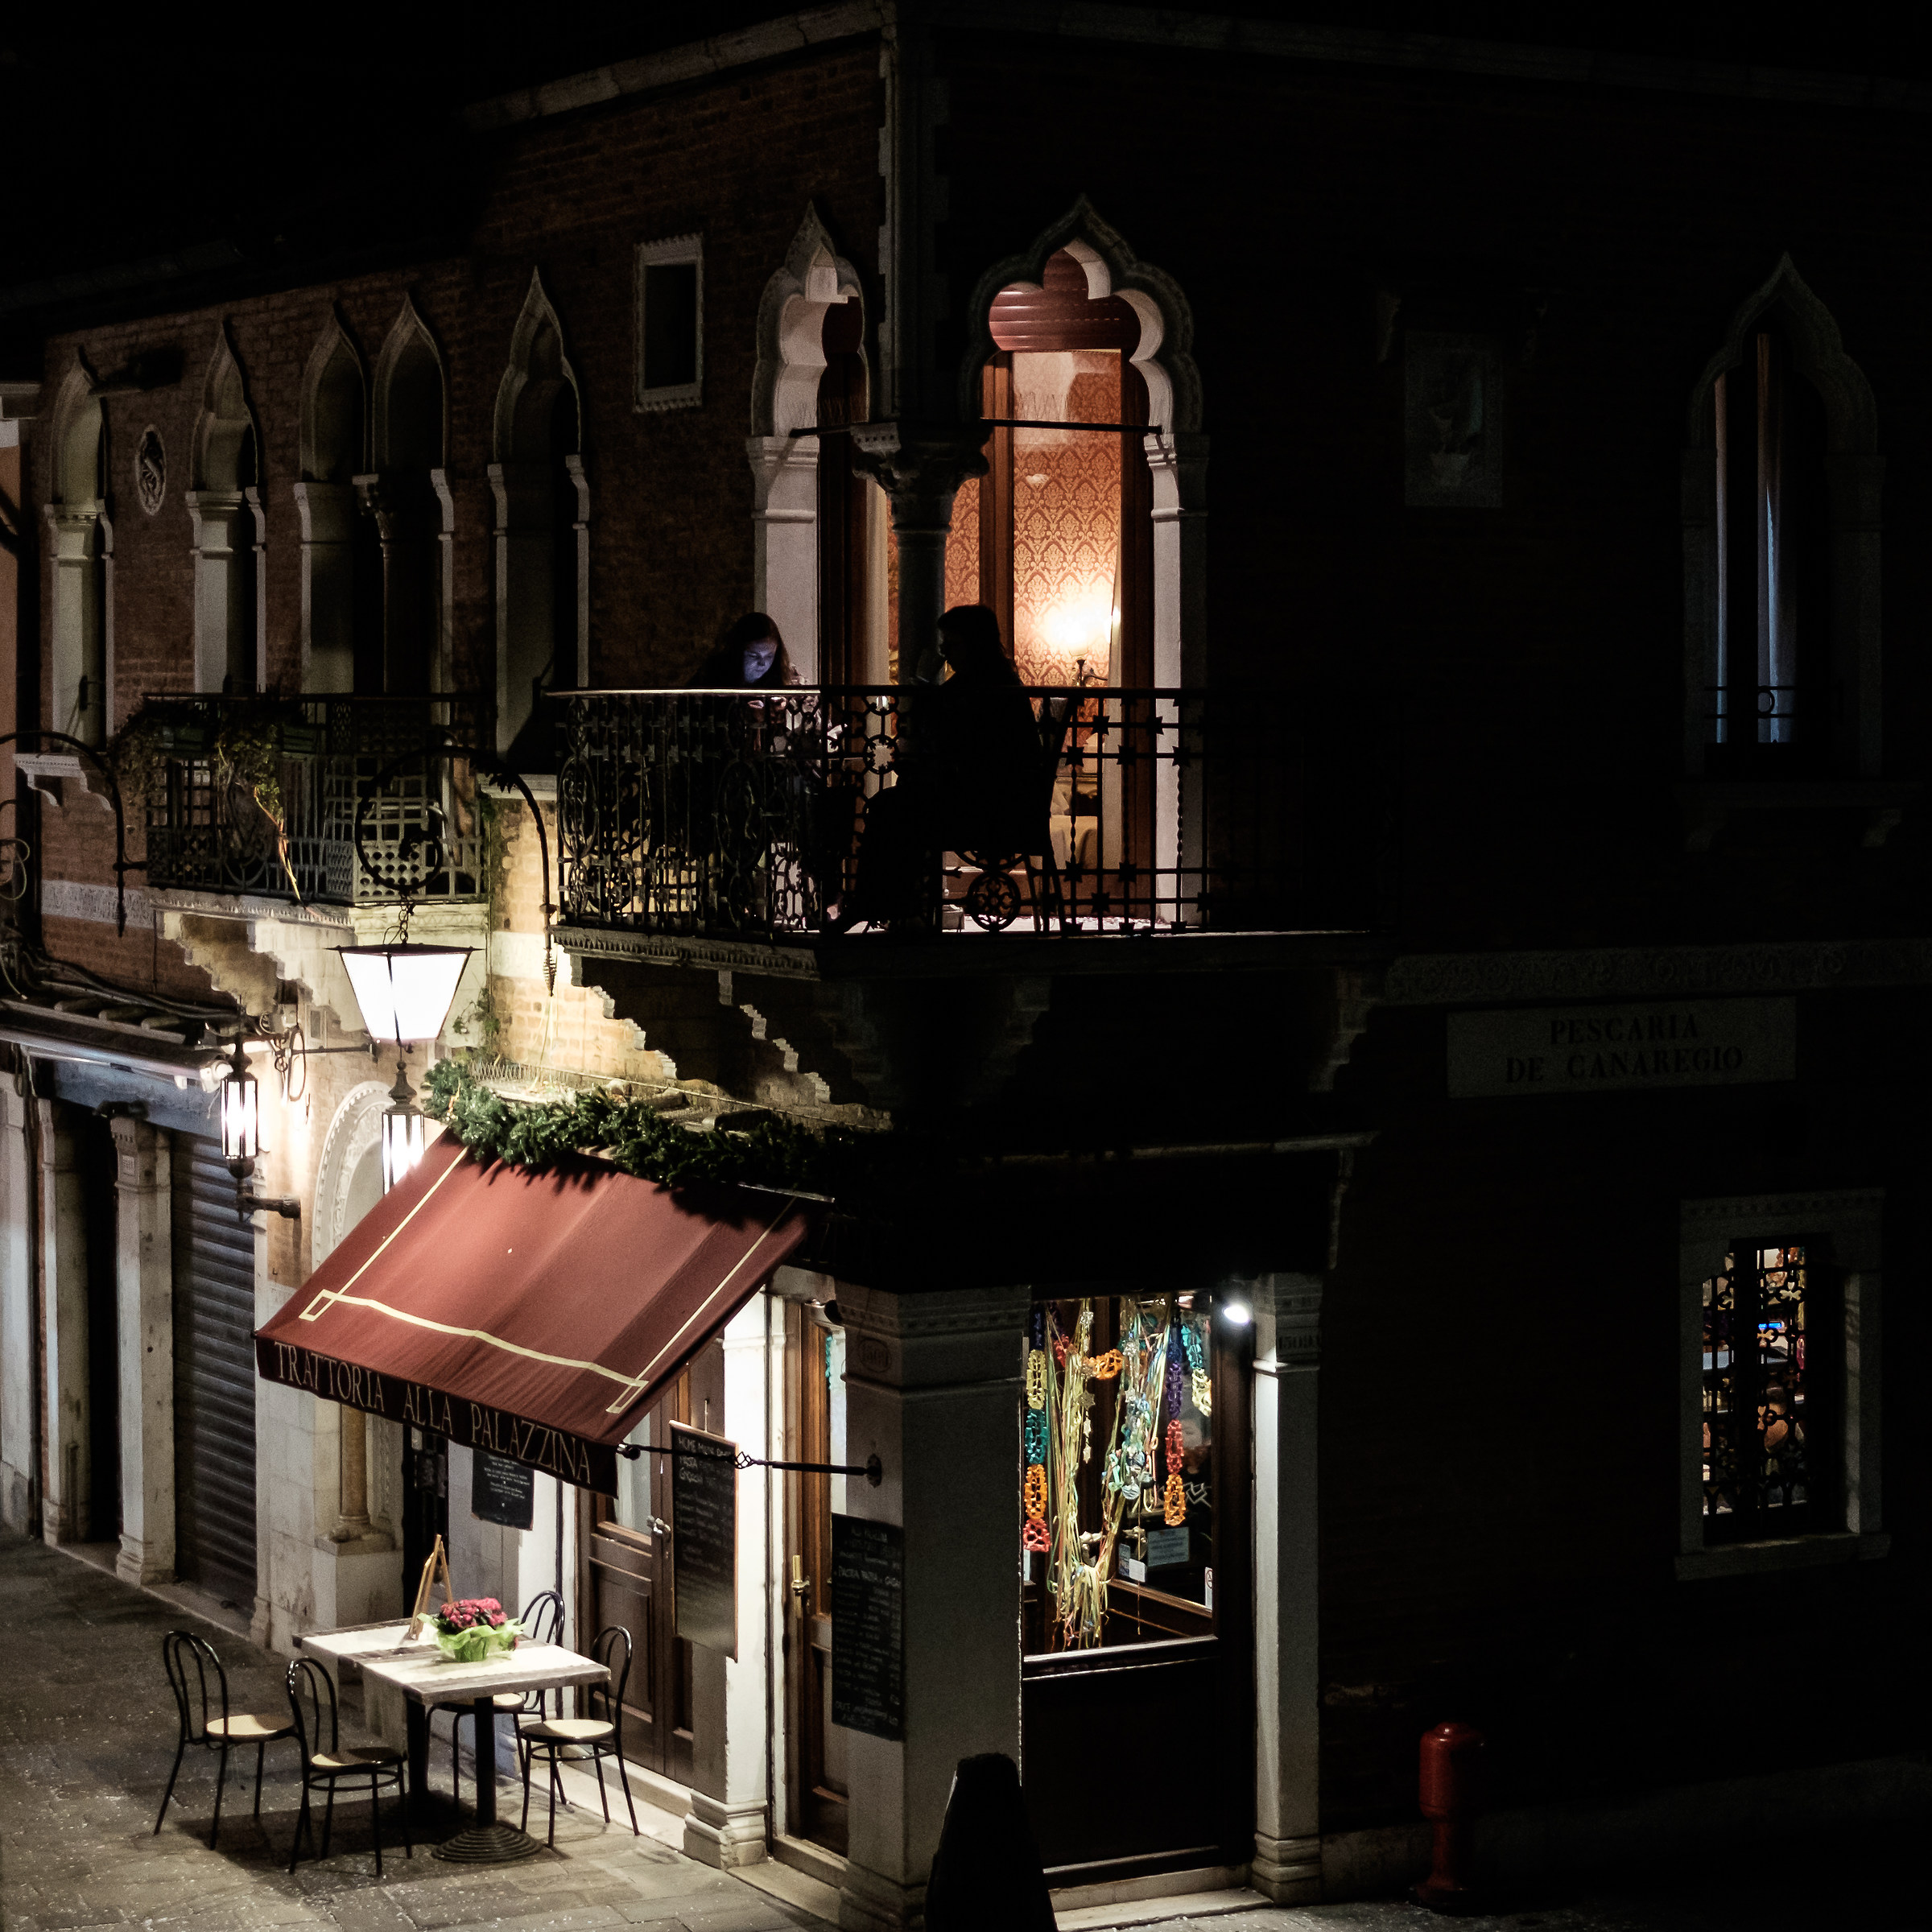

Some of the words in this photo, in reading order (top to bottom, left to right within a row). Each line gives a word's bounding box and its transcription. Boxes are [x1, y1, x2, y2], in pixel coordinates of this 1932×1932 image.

[1550, 1013, 1699, 1045] PESCARIA
[1506, 1056, 1545, 1084] DE
[1567, 1046, 1744, 1080] CANAREGIO
[275, 1341, 386, 1413] TRATTORIA
[402, 1383, 453, 1436] ALLA
[470, 1402, 591, 1484] PALAZZINA
